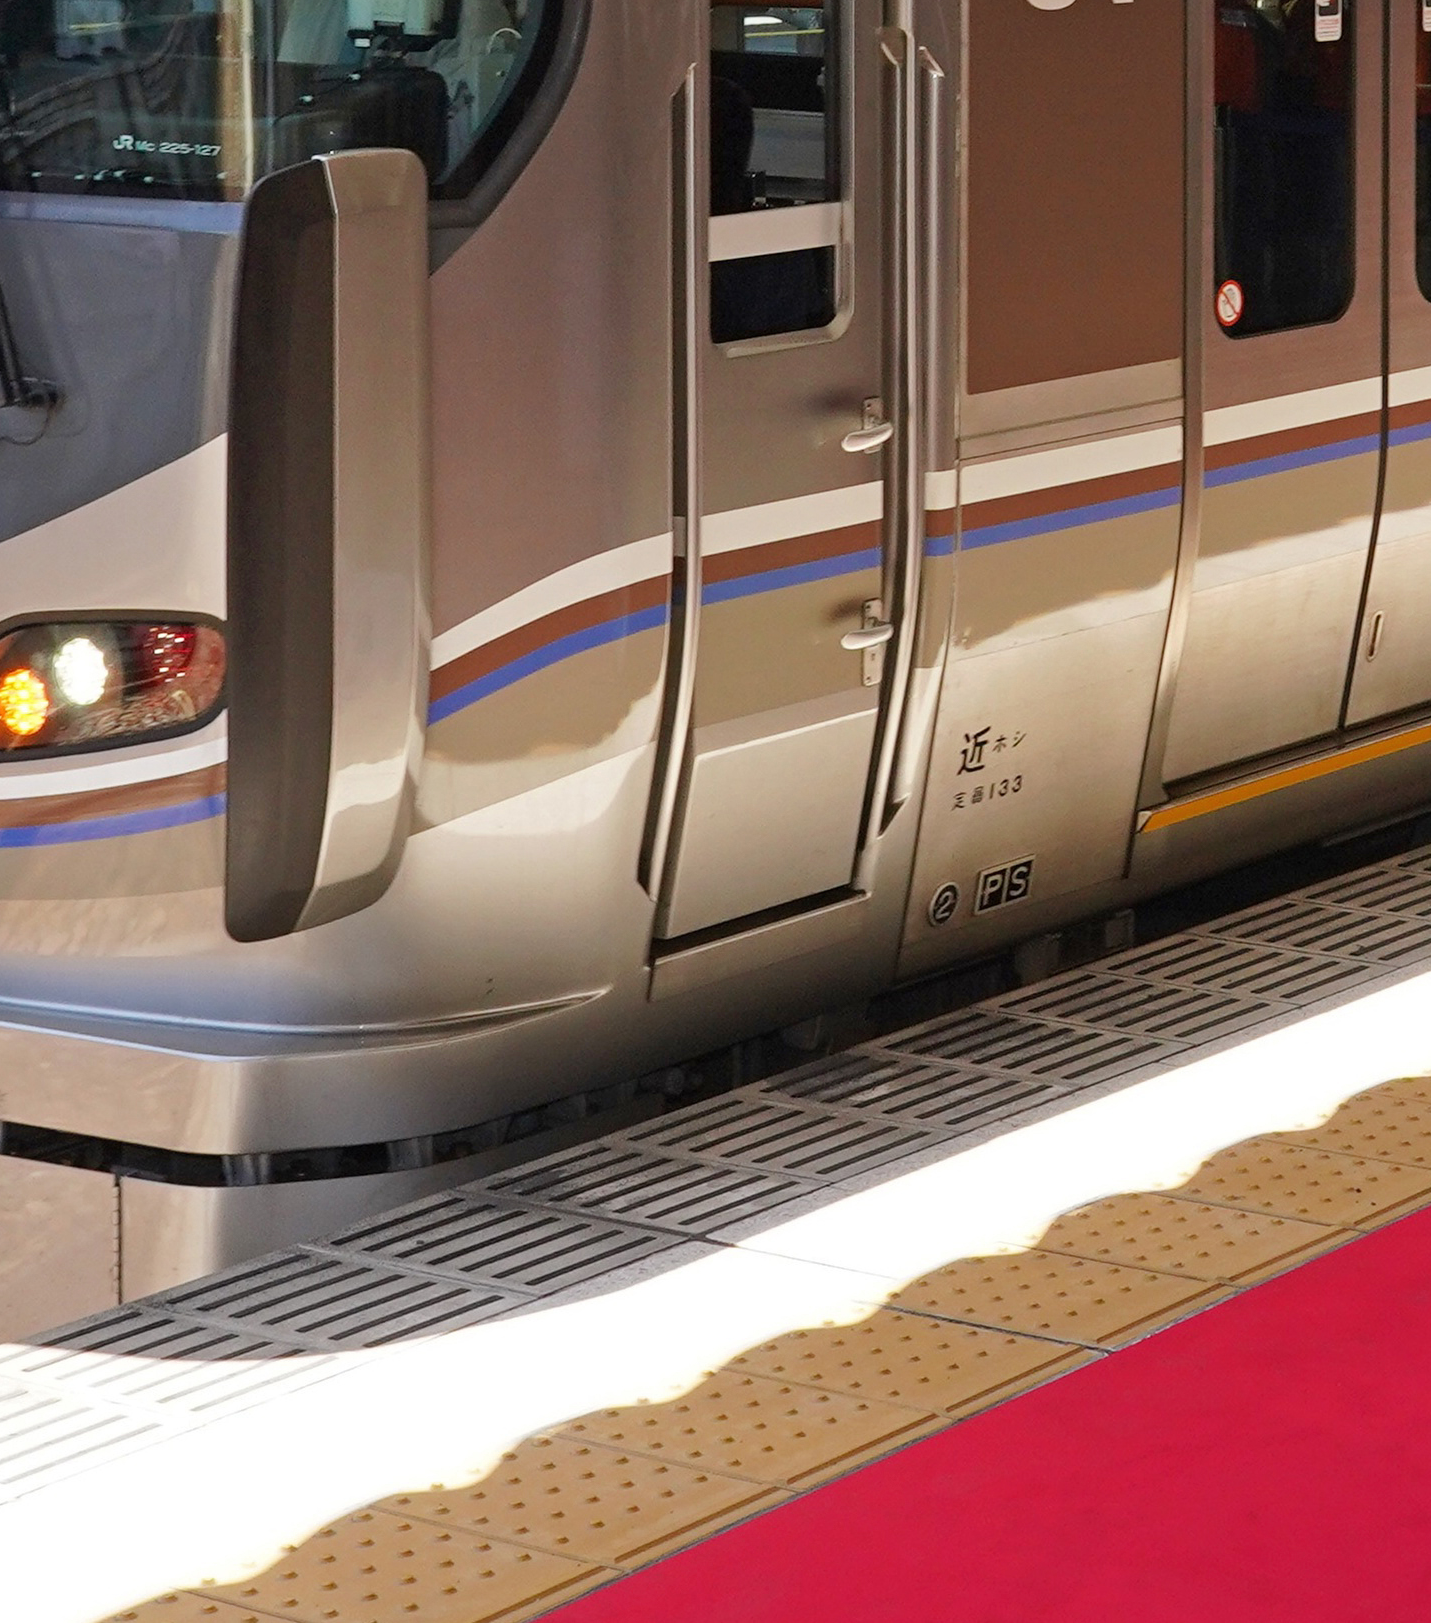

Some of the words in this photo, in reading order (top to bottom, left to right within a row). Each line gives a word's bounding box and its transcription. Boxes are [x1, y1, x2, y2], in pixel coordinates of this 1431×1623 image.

[112, 134, 135, 150] JR
[158, 142, 222, 156] 225-127
[982, 865, 1029, 907] PS
